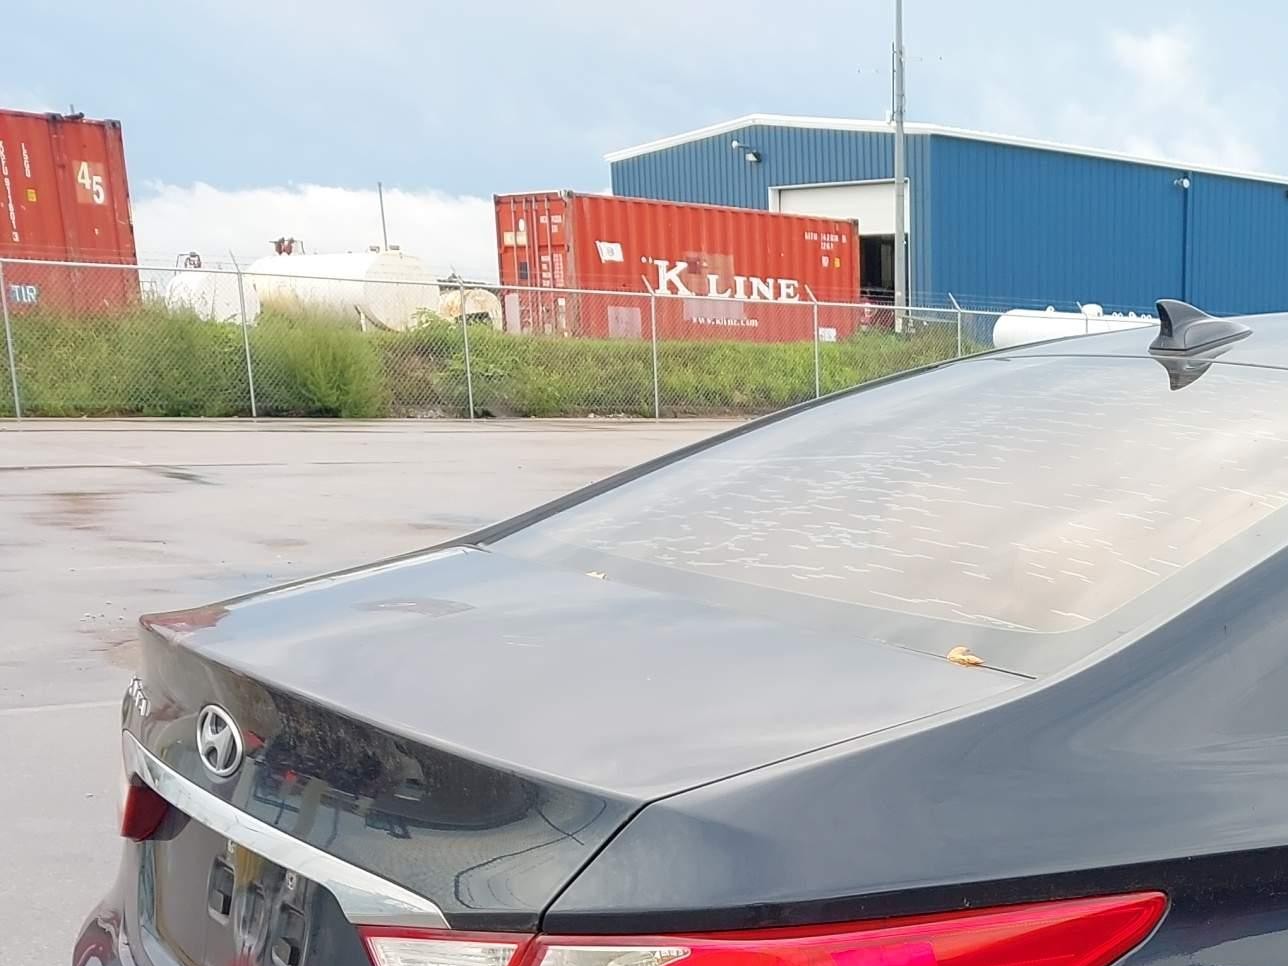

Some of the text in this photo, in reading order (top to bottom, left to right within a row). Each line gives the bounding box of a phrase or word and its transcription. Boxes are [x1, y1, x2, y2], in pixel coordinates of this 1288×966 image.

[77, 161, 105, 205] 45
[10, 284, 38, 304] TIR
[706, 273, 800, 301] LINE
